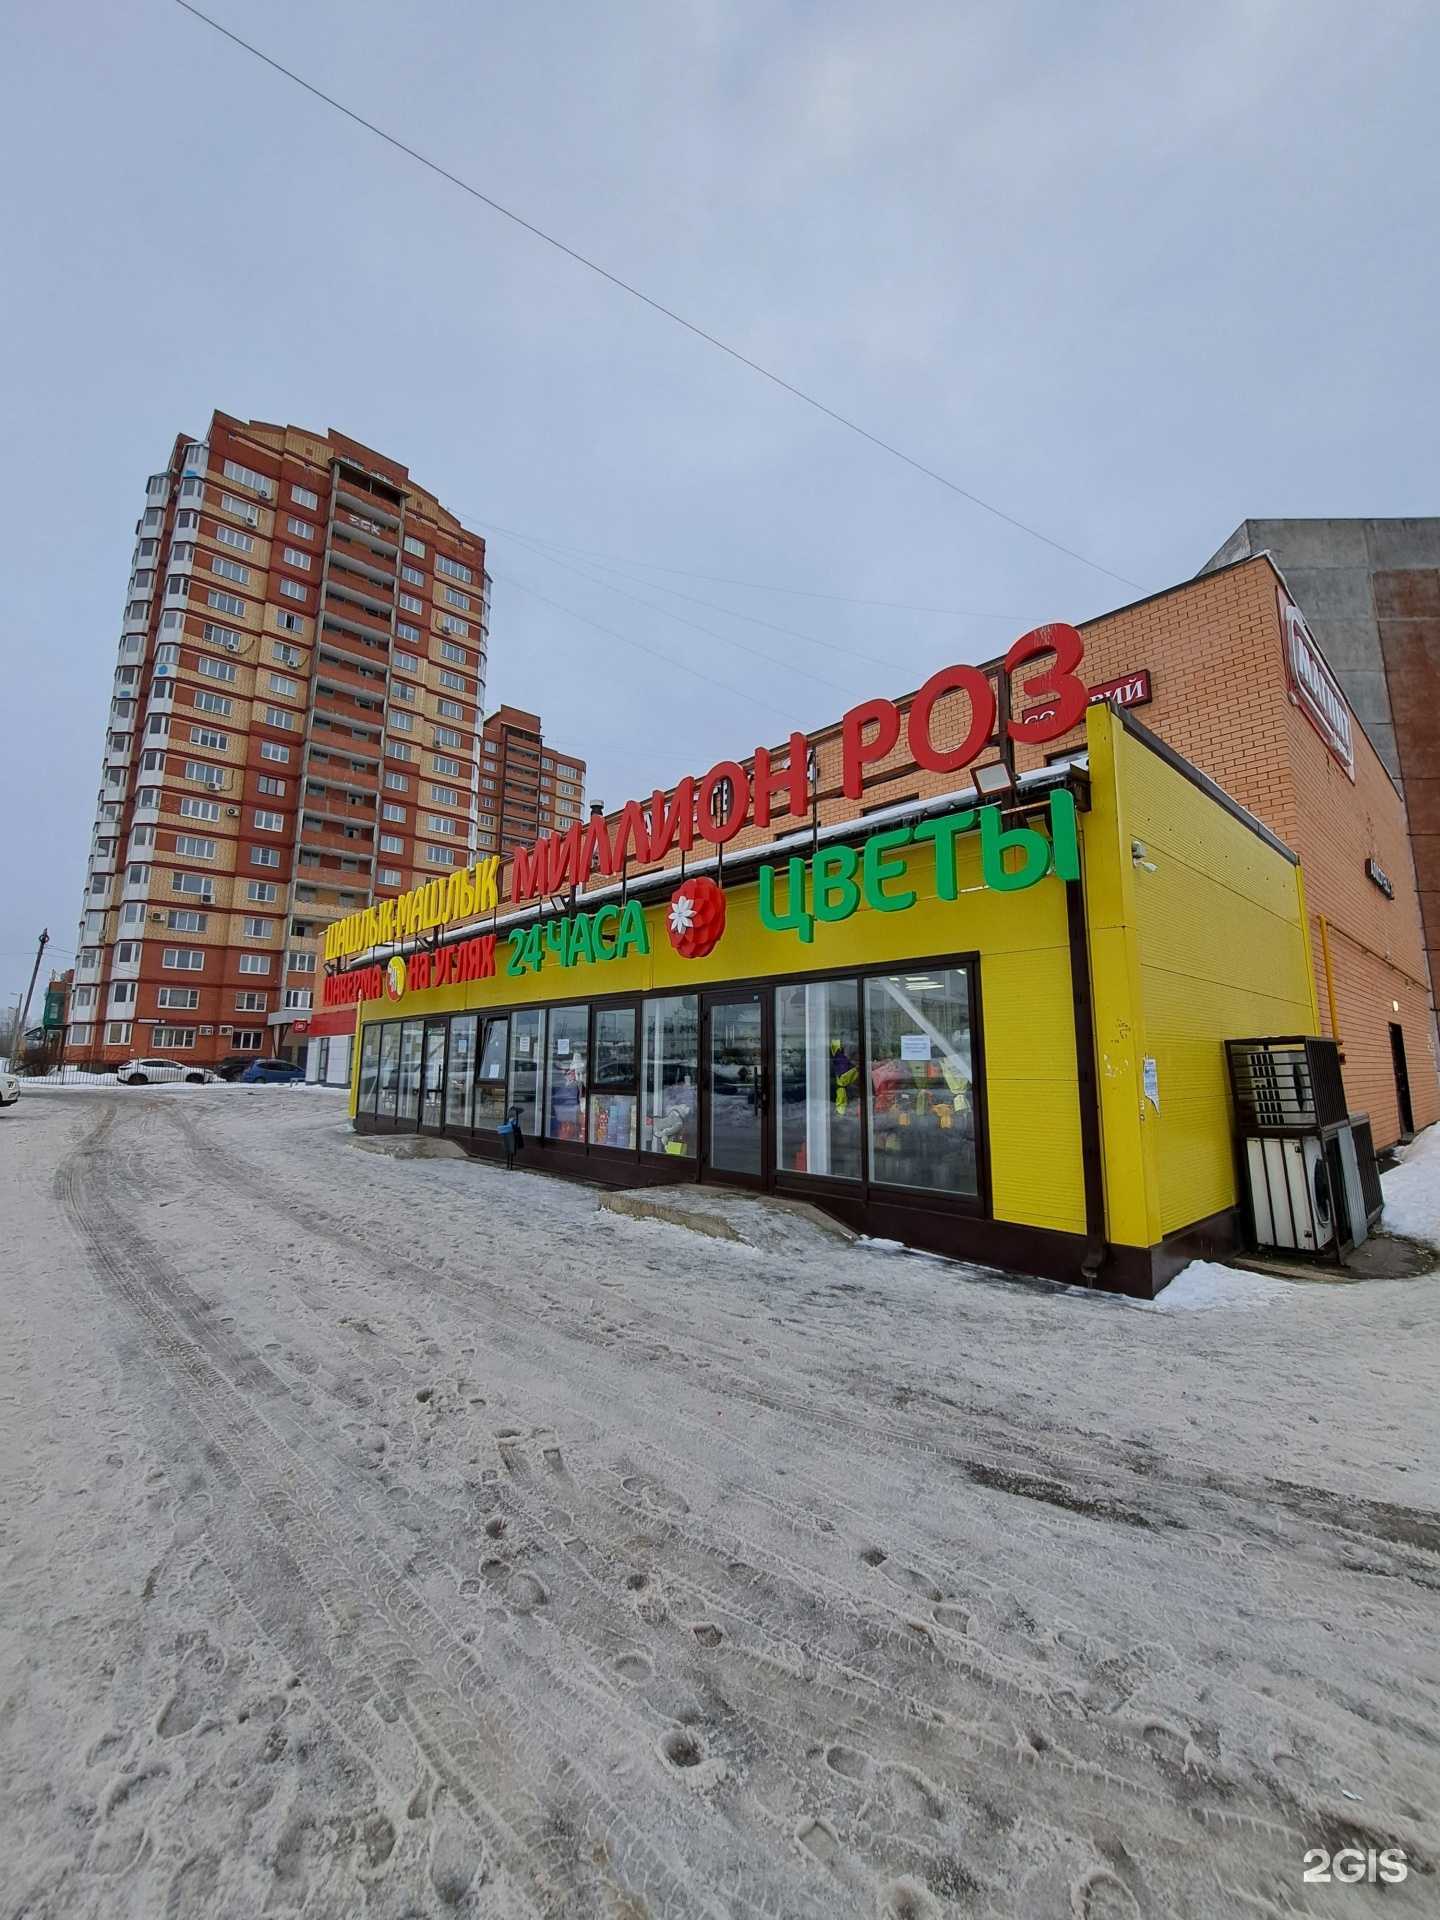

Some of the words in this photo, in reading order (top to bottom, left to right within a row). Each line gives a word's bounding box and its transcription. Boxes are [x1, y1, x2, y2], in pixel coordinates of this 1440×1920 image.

[512, 730, 810, 904] МИЛЛИОН
[843, 622, 1089, 800] РОЗ
[325, 855, 500, 960] ШАШЛЫК-МАШЛЫК
[758, 787, 1080, 943] ЦВЕТЫ
[323, 964, 383, 1007] ШАВЕРМА
[433, 934, 497, 987] УГЛЯХ
[507, 923, 545, 976] 24
[546, 899, 651, 968] ЧАСА
